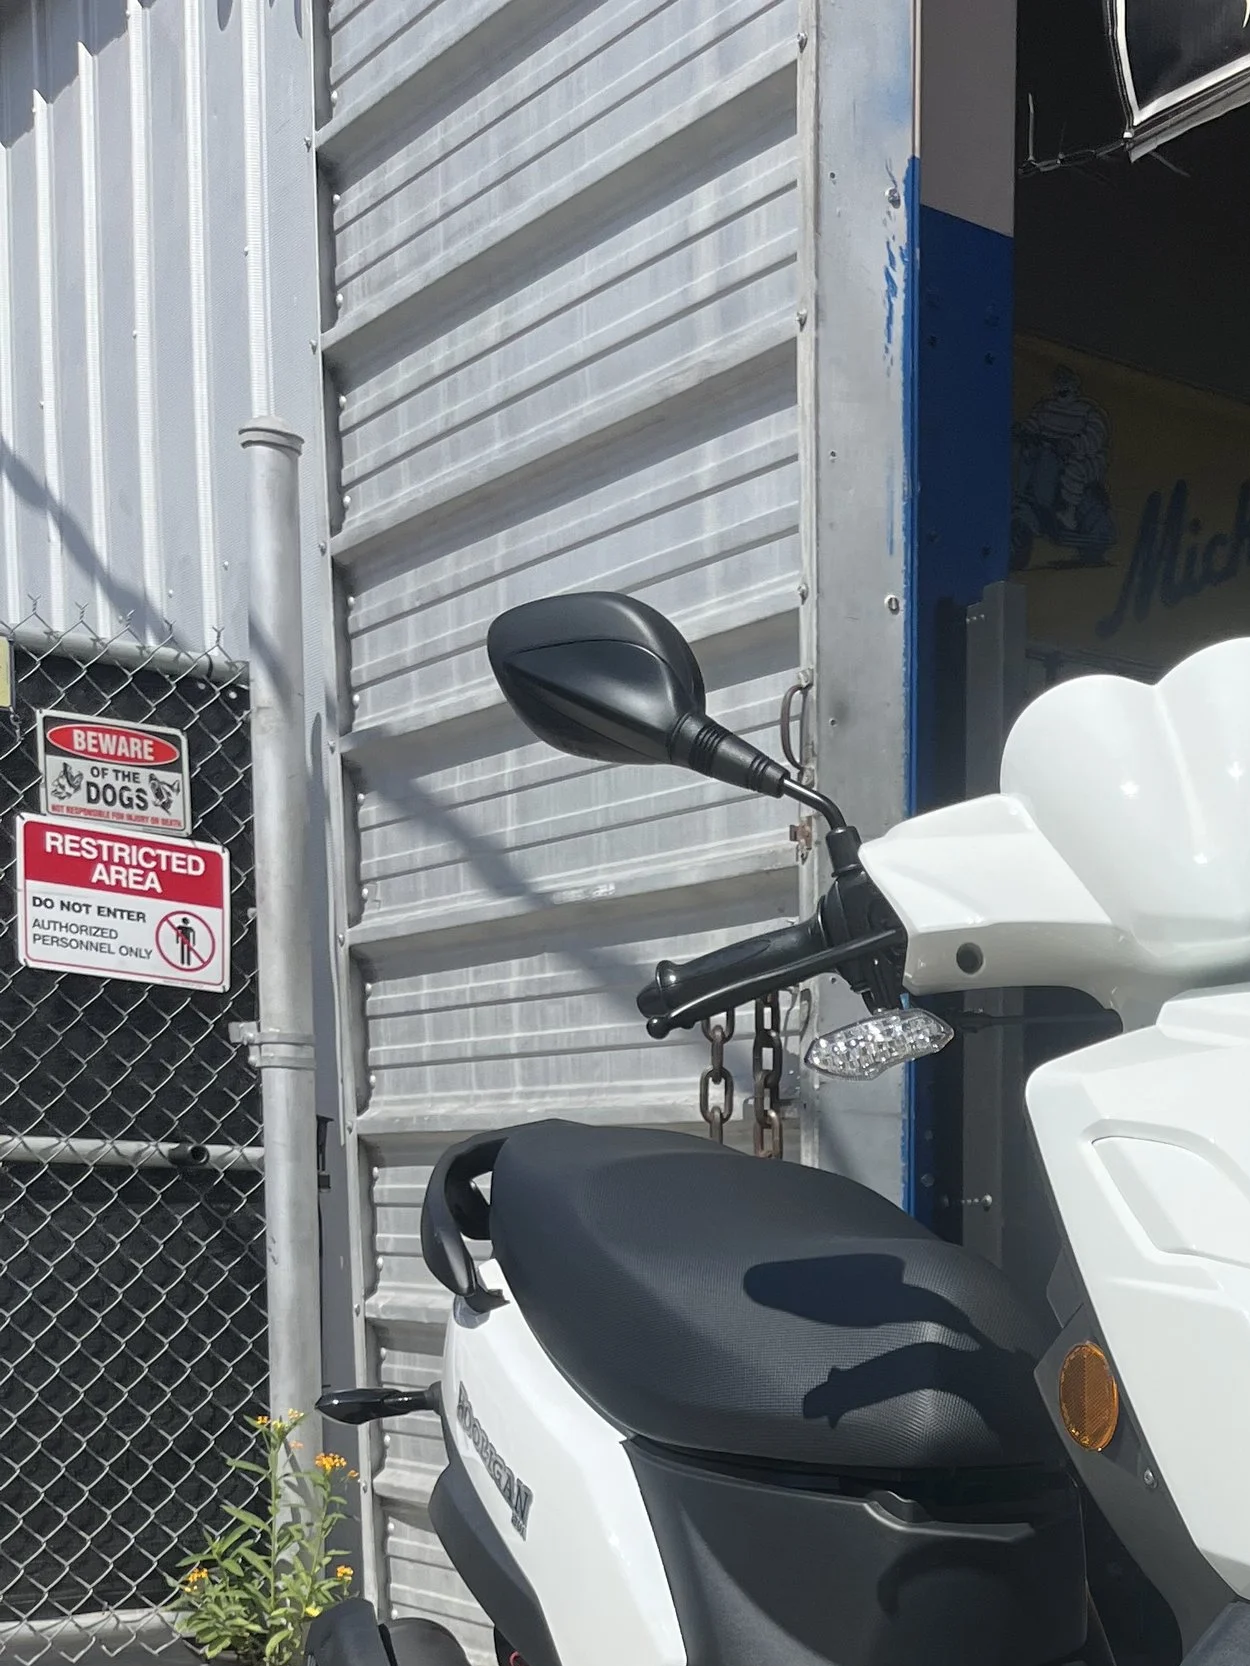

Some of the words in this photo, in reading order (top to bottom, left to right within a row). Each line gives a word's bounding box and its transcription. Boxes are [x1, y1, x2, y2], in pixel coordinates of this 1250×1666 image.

[72, 729, 155, 761] BEWARE
[90, 766, 109, 779] OF
[112, 769, 141, 784] THE
[86, 780, 149, 811] DOGS
[65, 805, 111, 819] RESPONSIBLE
[112, 811, 125, 821] FOR
[126, 813, 149, 824] INJURY
[45, 831, 206, 876] RESTRICTED
[91, 863, 163, 893] AREA
[32, 896, 54, 909] DO
[60, 899, 92, 915] NOT
[97, 906, 146, 923] ENTER
[32, 918, 119, 940] AUTHORIZED
[33, 934, 115, 955] PERSONNEL
[118, 945, 153, 960] ONLY
